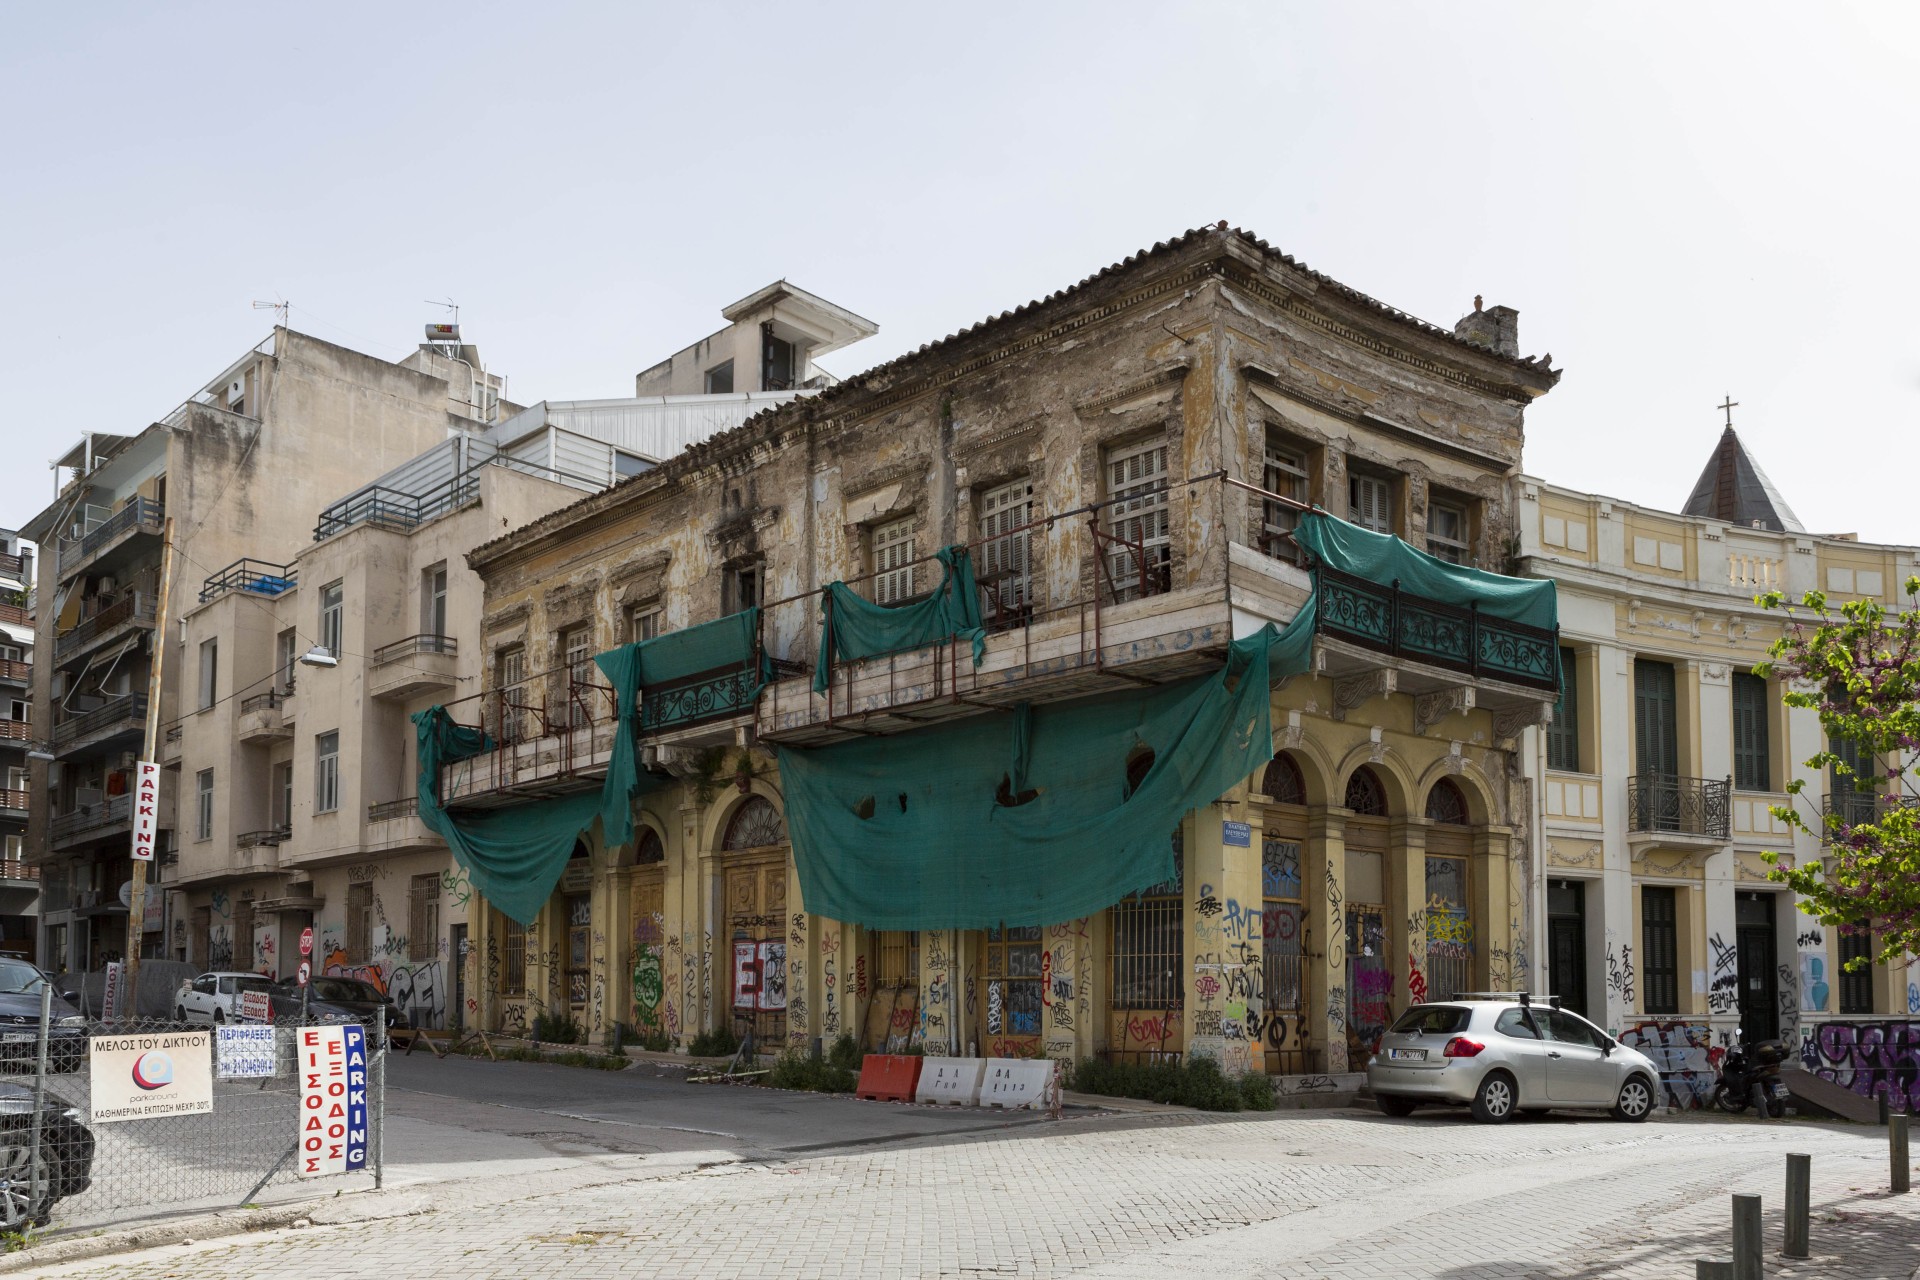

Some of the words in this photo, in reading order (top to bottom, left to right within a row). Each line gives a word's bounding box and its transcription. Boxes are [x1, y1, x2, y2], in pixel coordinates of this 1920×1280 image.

[136, 765, 155, 857] PARKING
[301, 935, 313, 948] STOP
[243, 992, 268, 1005] ΕΙΣΟΔΟΣ
[243, 1006, 266, 1018] ΕΞΟΔΟΣ
[220, 1029, 272, 1040] ΠΕΡΙΦΡΑΞΕΙΣ
[95, 1040, 135, 1052] ΜΕΛΟΣ
[139, 1038, 160, 1050] ΤΟΥ
[162, 1036, 207, 1049] ΔΙΚΤΥΟΥ
[129, 1092, 178, 1104] parkaround
[304, 1031, 323, 1174] ΕΙΣΟΔΟΣ
[328, 1040, 345, 1159] ΕΞΟΔΟΣ
[347, 1032, 365, 1163] PARKING
[95, 1106, 142, 1119] ΚΑΘΗΜΕΡΙΝΑ
[144, 1104, 173, 1115] ΕΚΠΤΩΣΗ
[175, 1101, 196, 1112] ΜΕΧΡΙ
[196, 1100, 210, 1110] 30%
